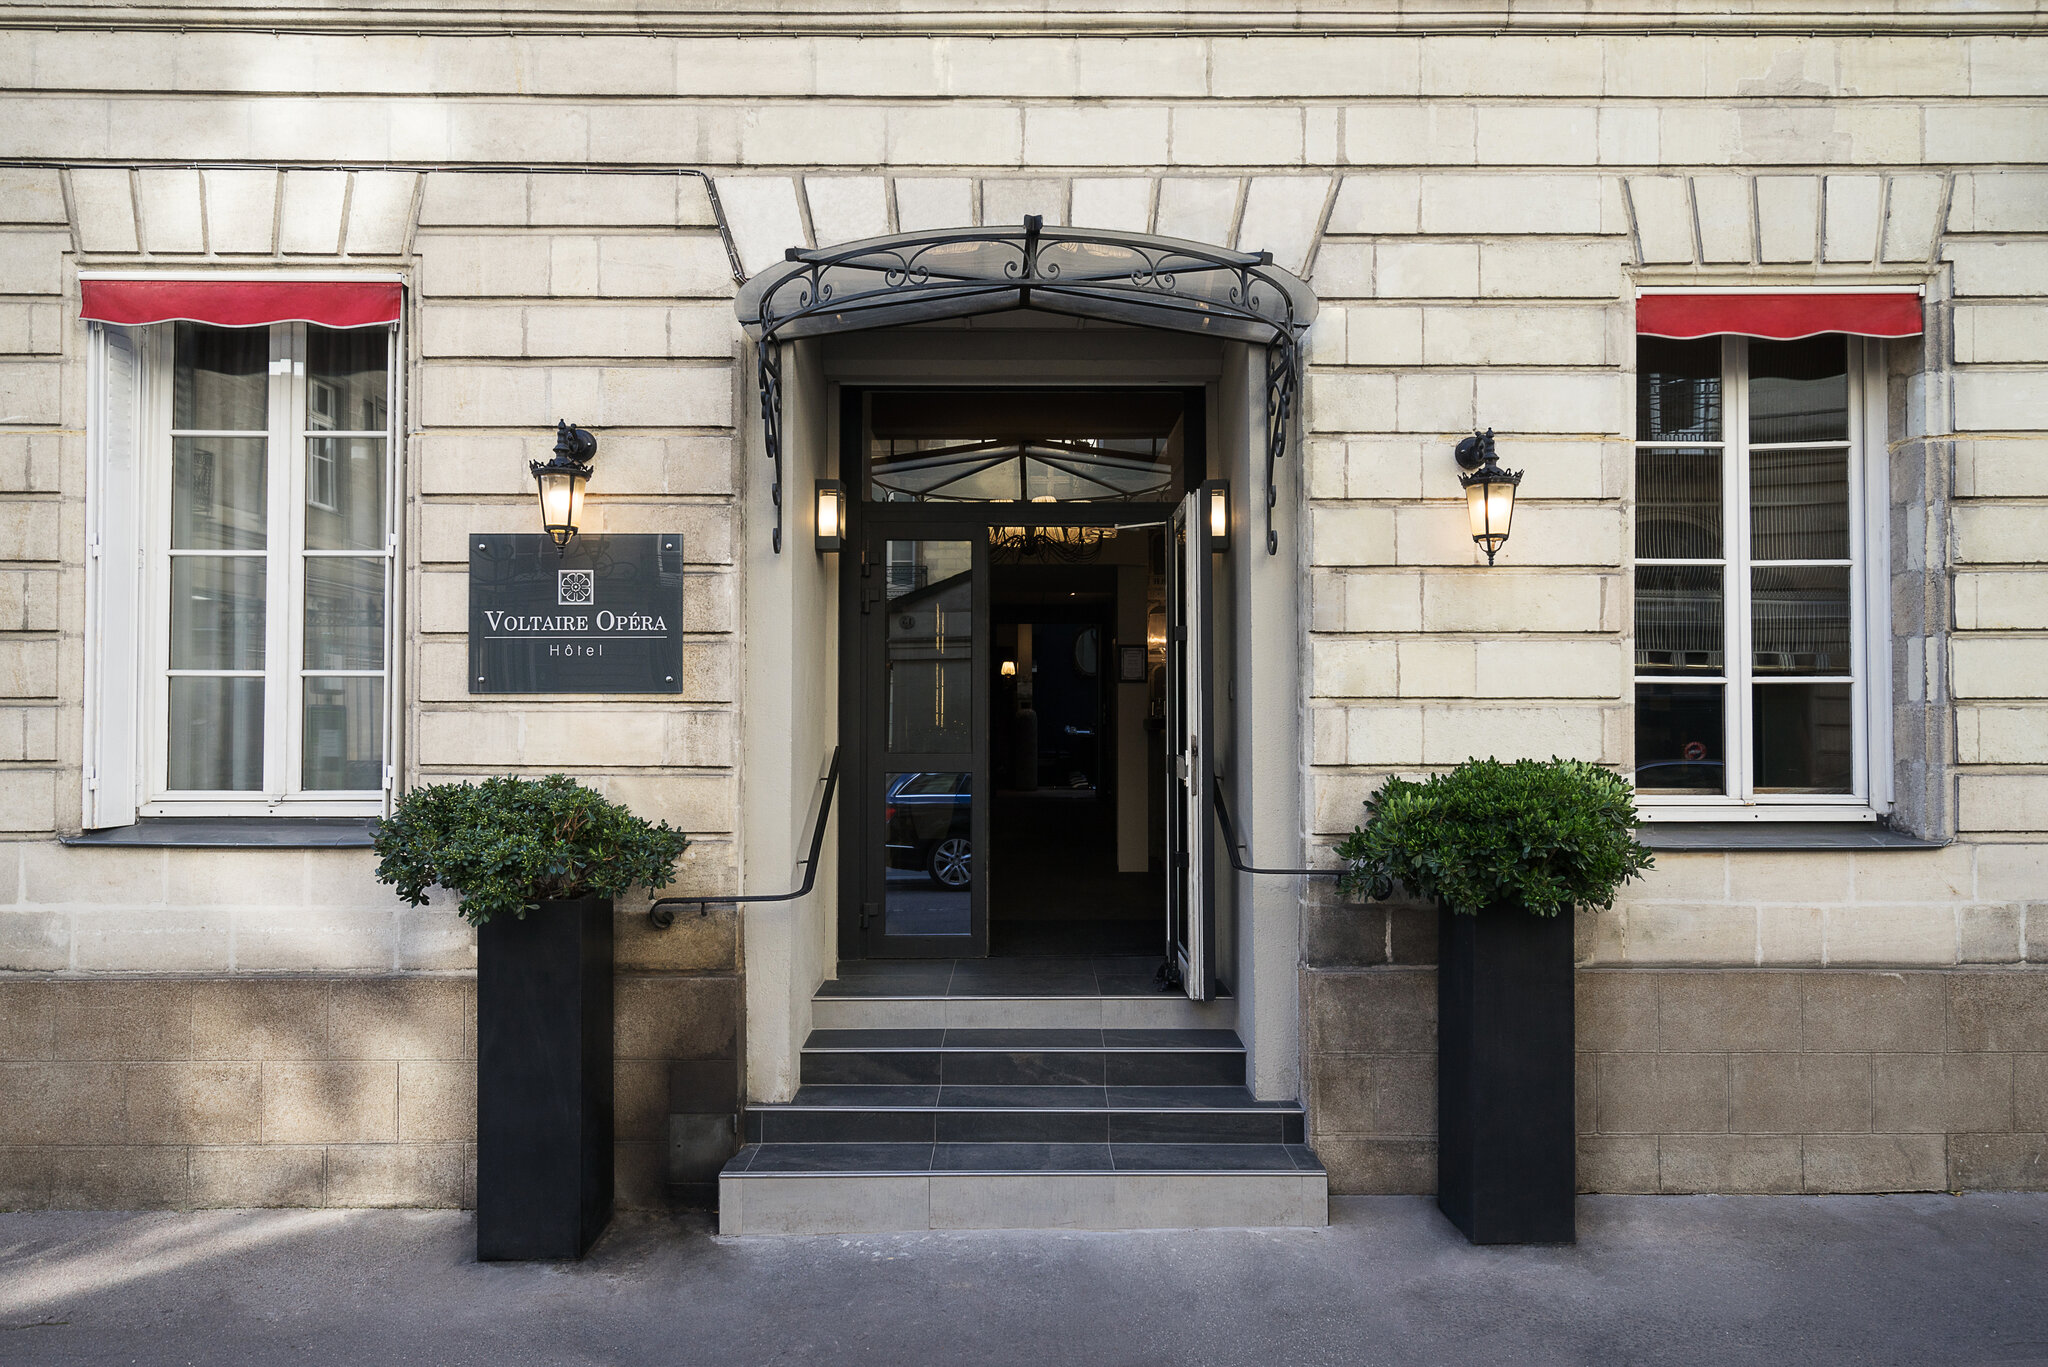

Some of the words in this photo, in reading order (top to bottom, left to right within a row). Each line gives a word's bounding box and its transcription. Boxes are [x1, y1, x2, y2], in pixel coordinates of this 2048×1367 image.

[484, 610, 589, 631] VOLTAIRE
[596, 610, 667, 631] OPÉRA
[550, 644, 602, 657] Hôtel
